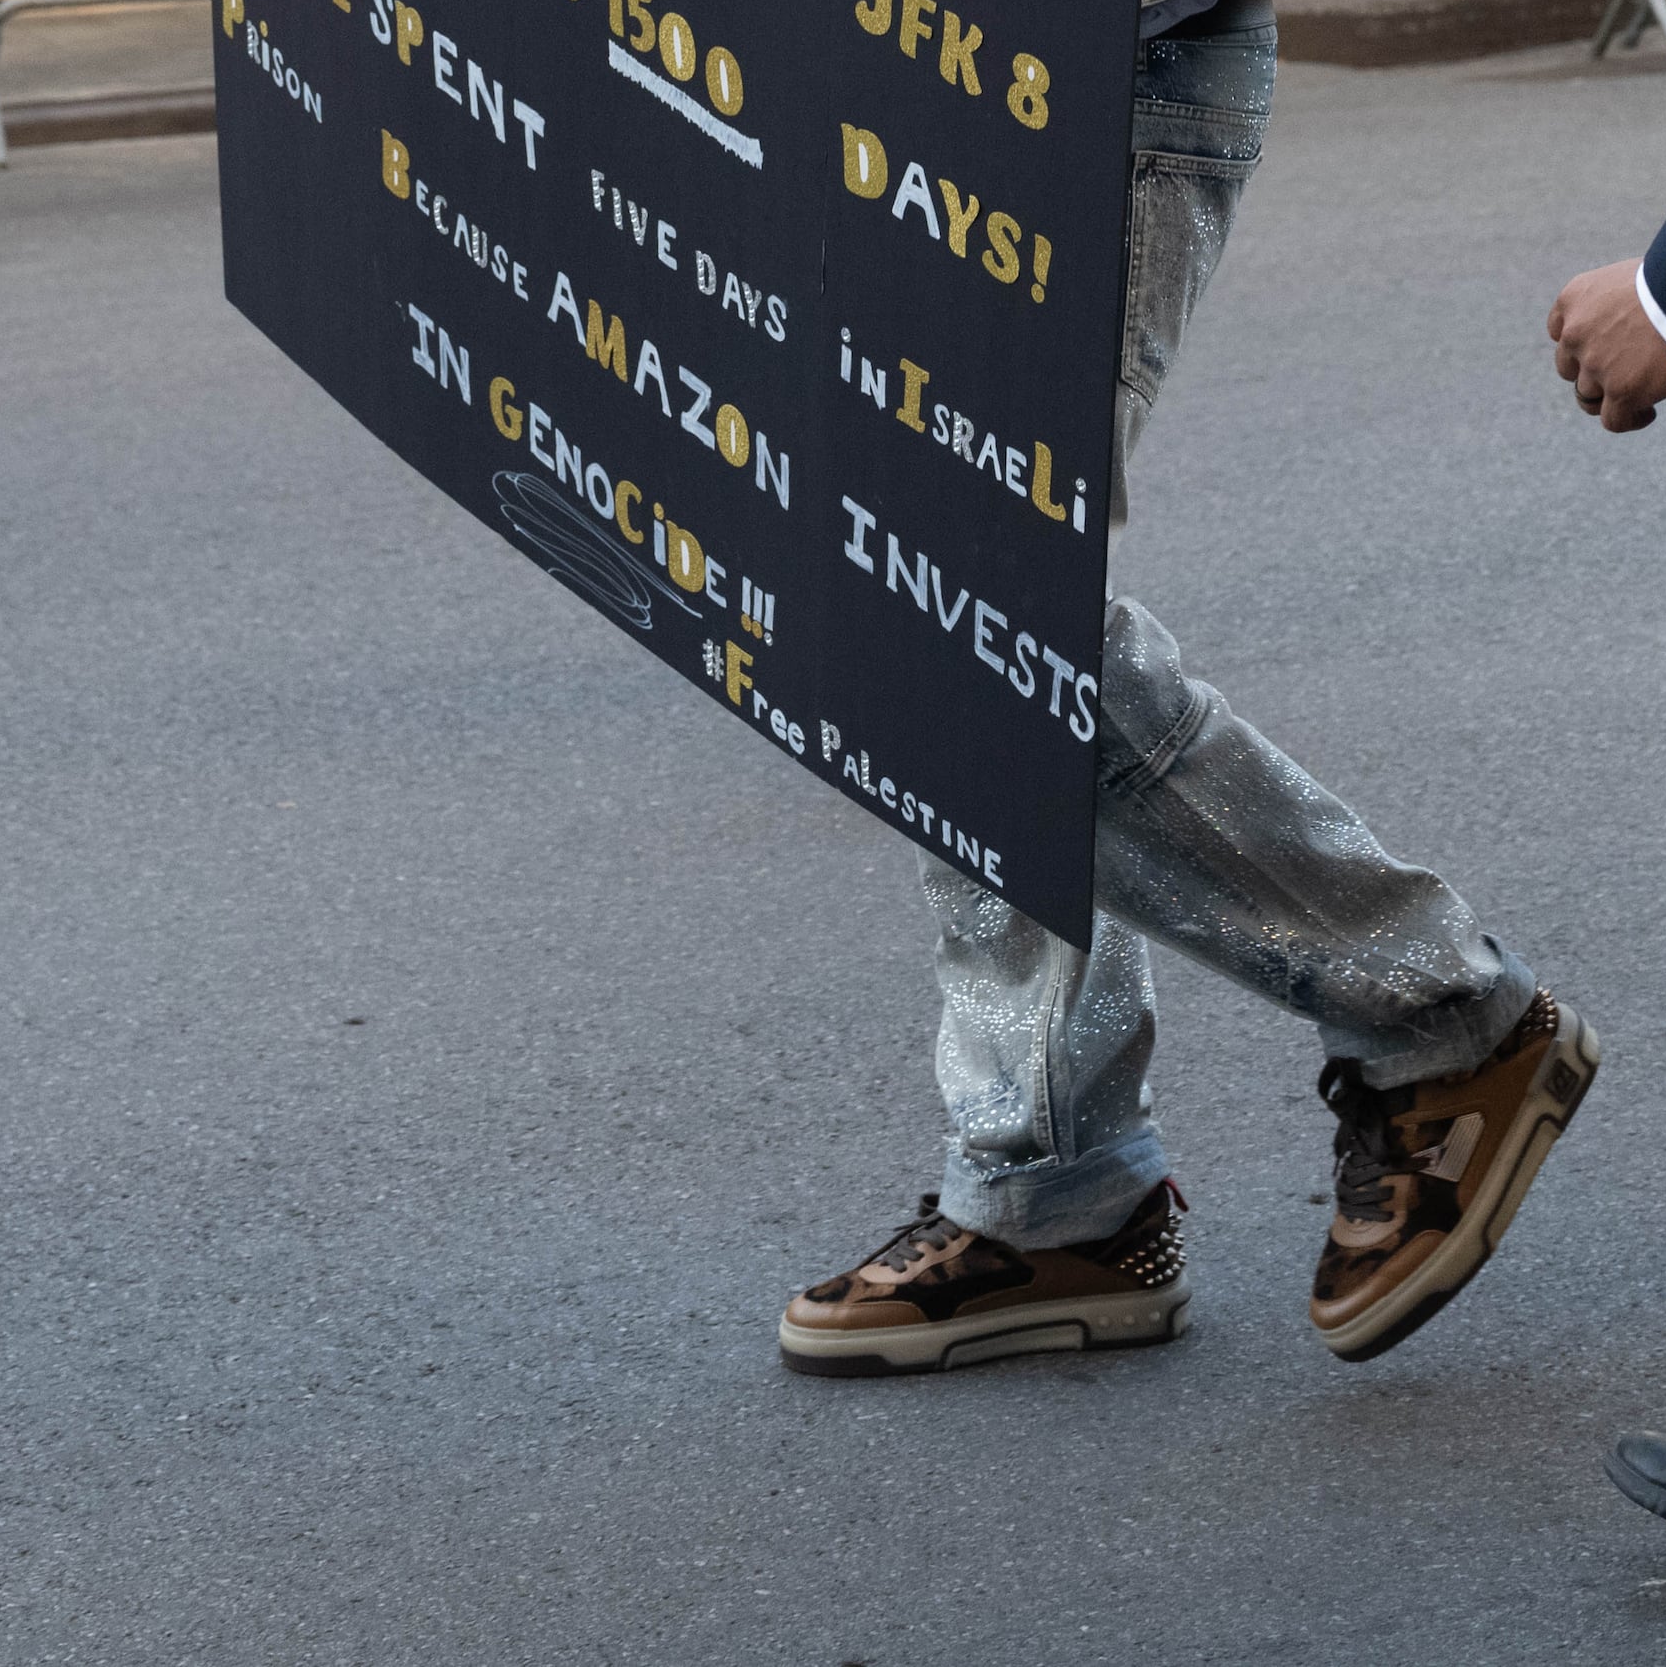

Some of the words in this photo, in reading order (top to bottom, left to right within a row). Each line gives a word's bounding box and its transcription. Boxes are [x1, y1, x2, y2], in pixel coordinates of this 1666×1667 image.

[591, 168, 678, 271] FIVE
[694, 249, 789, 343] DAYS
[841, 123, 1053, 304] DAYS!
[380, 128, 530, 303] BECAUSE
[546, 271, 790, 511] AMAZON
[841, 494, 1099, 743] INVESTS
[408, 302, 471, 406] IN
